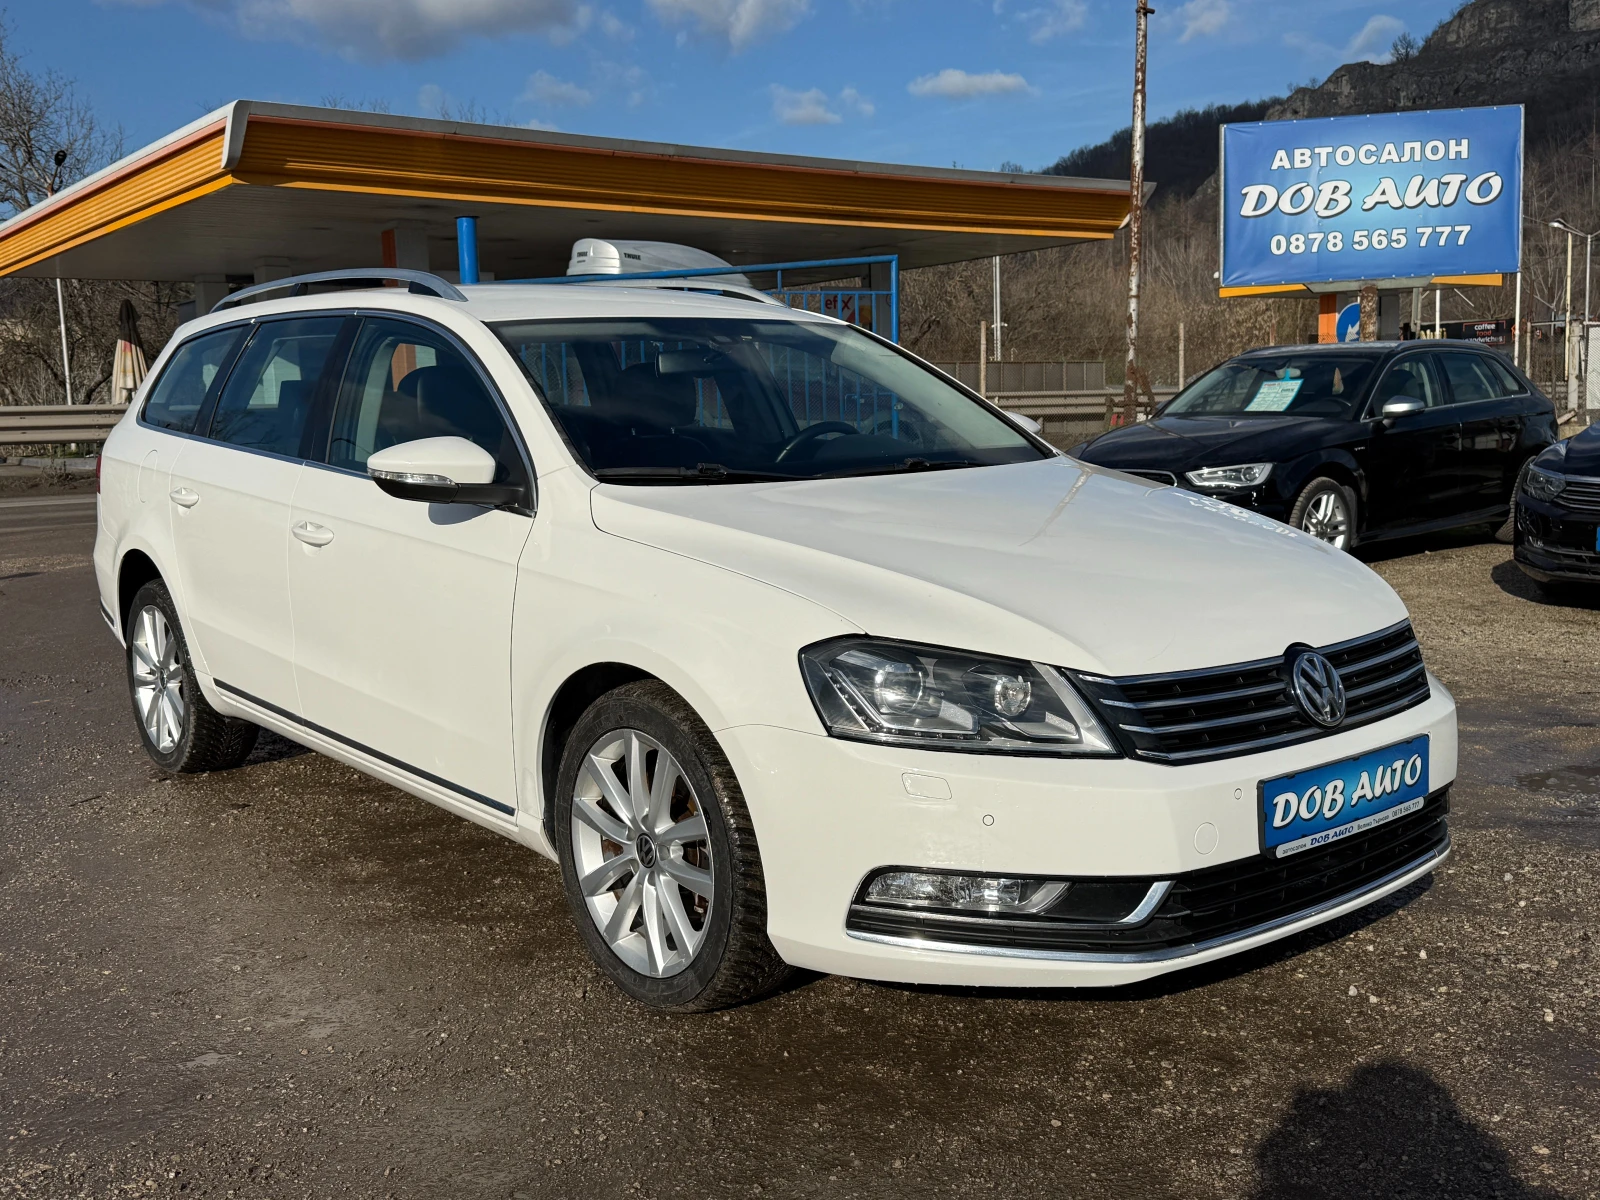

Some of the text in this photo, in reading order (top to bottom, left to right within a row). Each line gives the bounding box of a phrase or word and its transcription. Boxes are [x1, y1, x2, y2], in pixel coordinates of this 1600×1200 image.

[1270, 138, 1470, 170] АВТОСАЛОН
[1240, 171, 1503, 218] DOB AUTO
[1270, 224, 1472, 255] 0878 565 777
[623, 252, 642, 261] THULE
[825, 295, 852, 312] efx
[1474, 323, 1496, 331] coffee
[1272, 753, 1422, 828] DOB AUTO
[1310, 833, 1330, 846] DOB
[1331, 826, 1354, 840] AUTO
